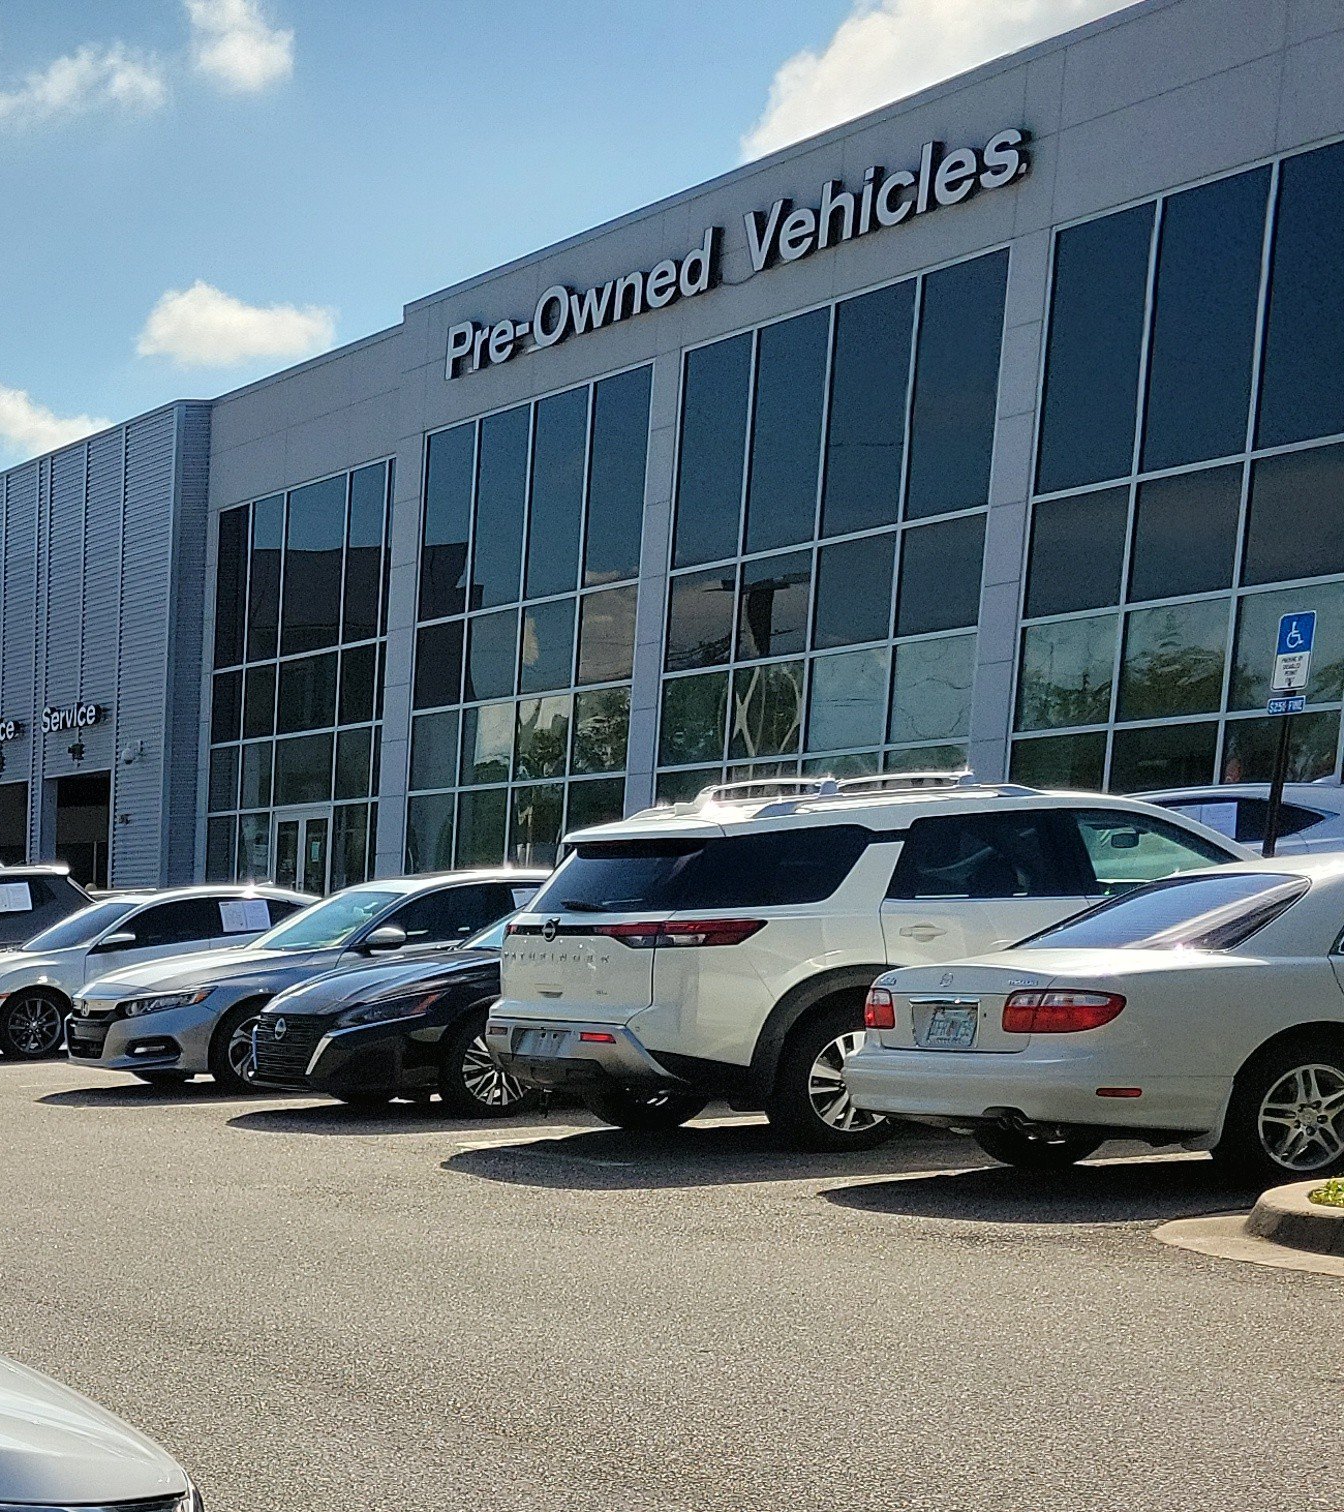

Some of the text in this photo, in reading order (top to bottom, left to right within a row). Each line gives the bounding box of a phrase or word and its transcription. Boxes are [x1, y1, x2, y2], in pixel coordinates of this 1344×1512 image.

[445, 128, 1022, 380] Pre-Owned Vehicles
[41, 702, 96, 733] Service
